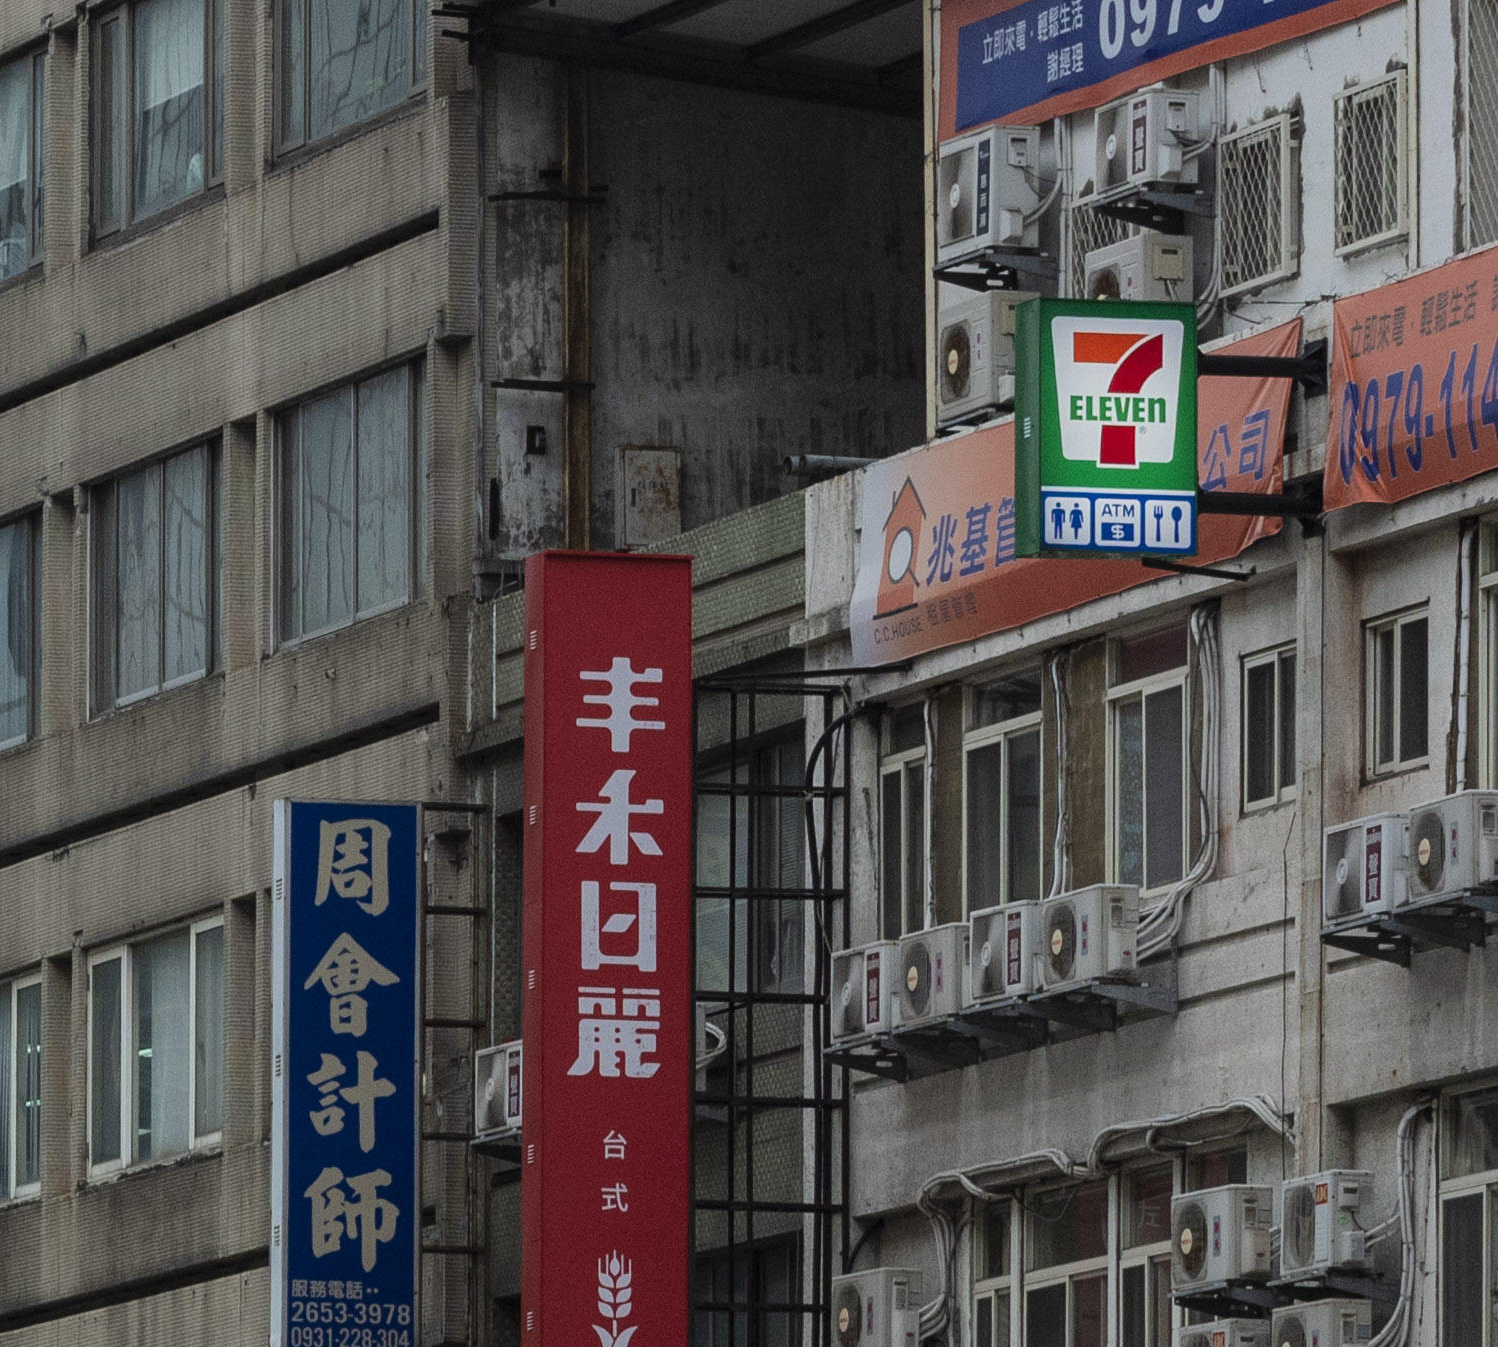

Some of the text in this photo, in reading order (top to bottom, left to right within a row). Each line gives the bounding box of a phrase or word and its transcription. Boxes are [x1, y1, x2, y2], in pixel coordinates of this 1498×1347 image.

[1202, 409, 1268, 490] 公司
[1100, 503, 1136, 519] ATM
[303, 818, 401, 1273] 周會計師
[600, 1130, 630, 1214] 台式
[291, 1302, 411, 1326] 2653-3978
